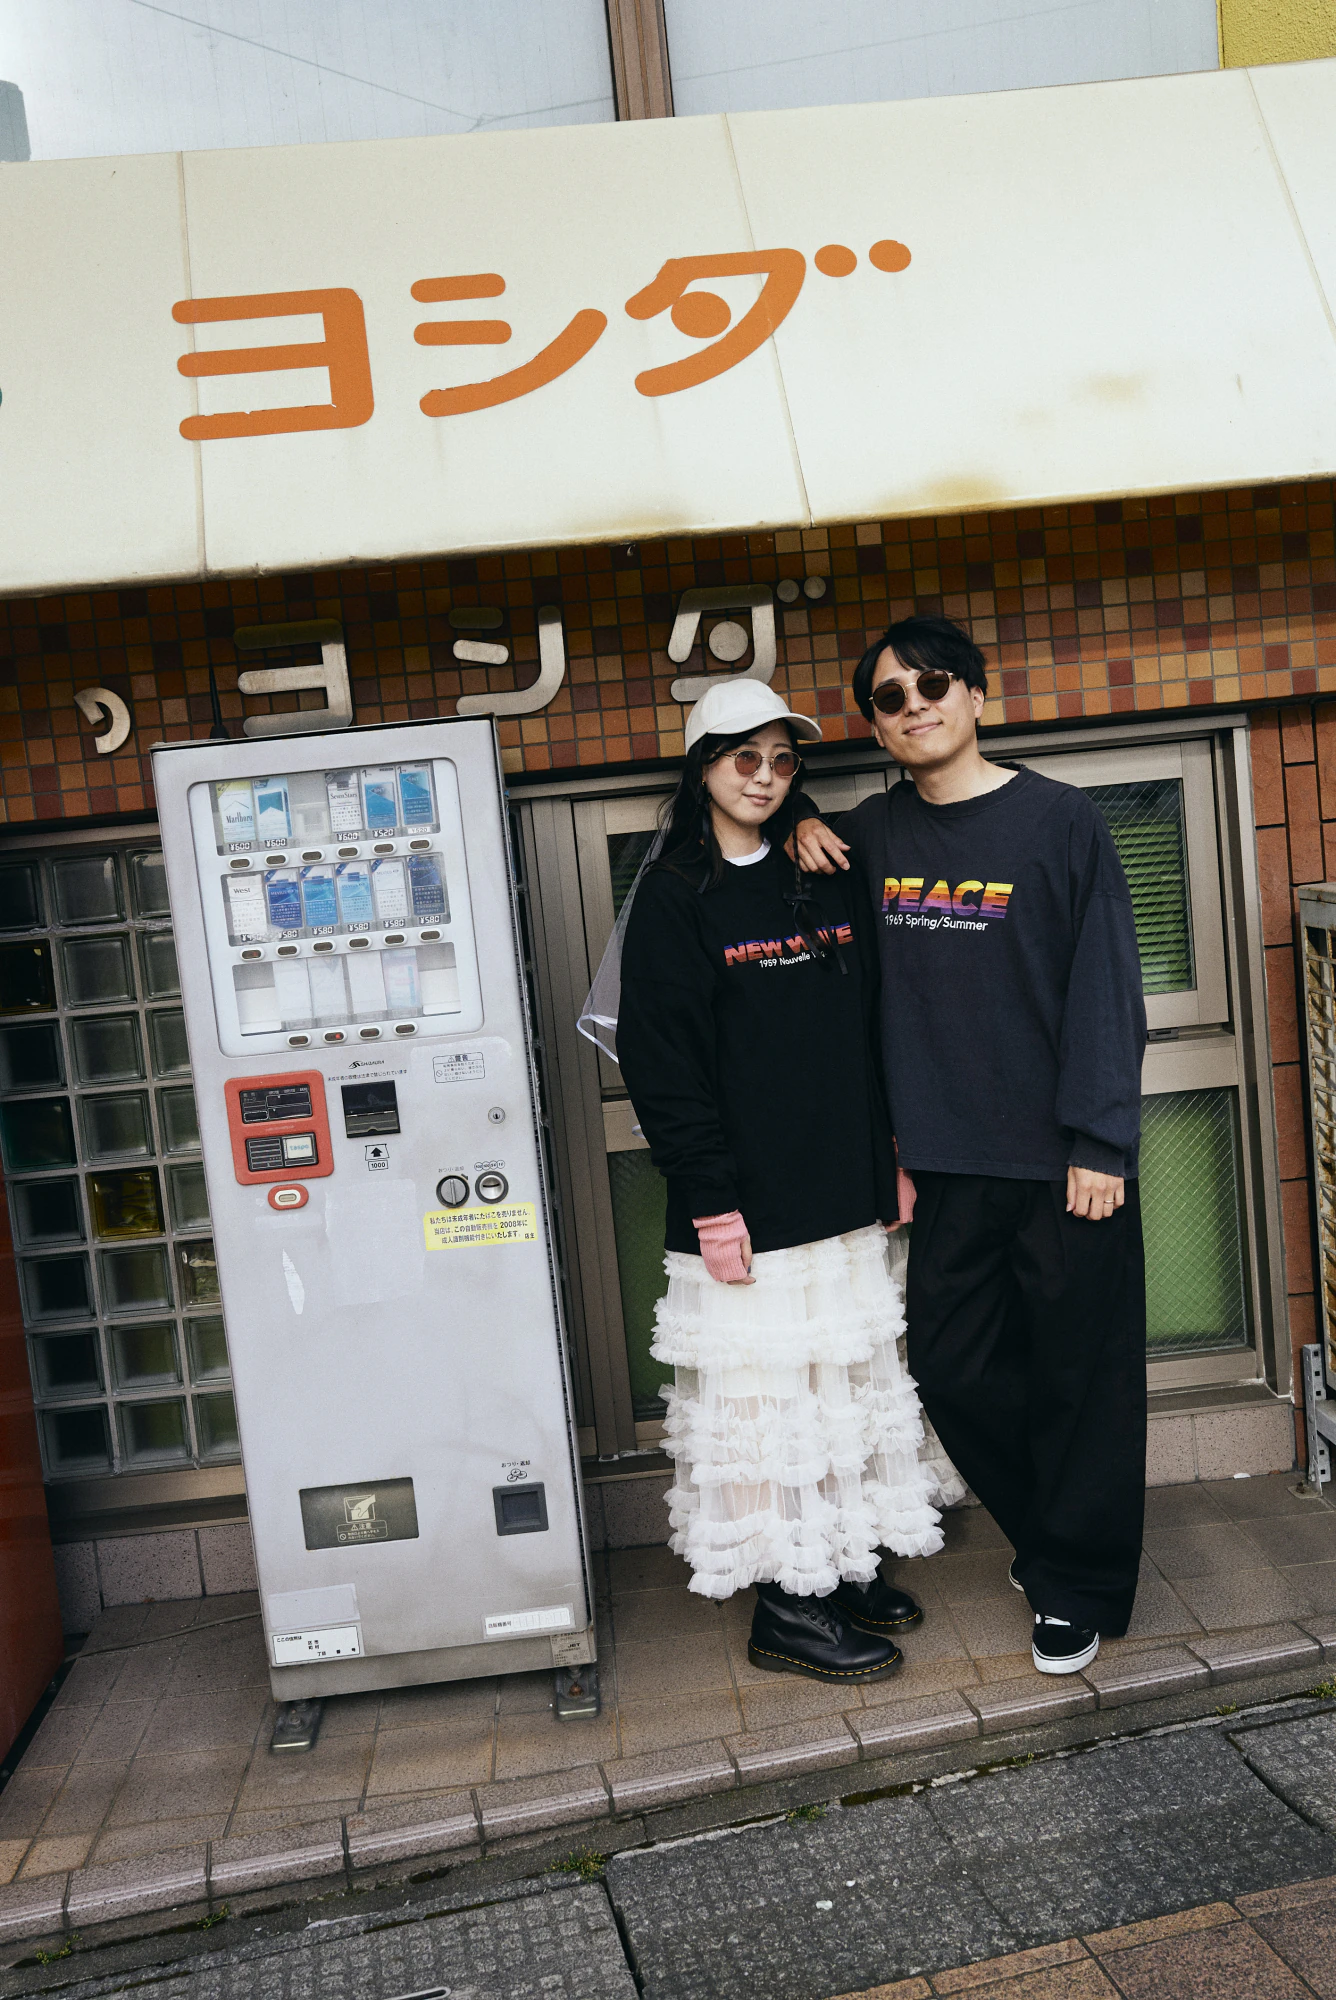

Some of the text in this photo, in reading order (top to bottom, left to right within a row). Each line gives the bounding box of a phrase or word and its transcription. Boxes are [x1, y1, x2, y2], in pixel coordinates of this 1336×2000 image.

[171, 239, 912, 441] ヨシダ
[232, 575, 827, 738] ヨシダ
[226, 812, 253, 824] Marlboro
[338, 833, 358, 841] ¥600
[373, 829, 394, 838] ¥520
[230, 842, 250, 851] ¥600
[266, 838, 286, 847] ¥600
[881, 877, 1014, 919] PEACE
[384, 919, 404, 928] ¥580
[420, 915, 440, 924] ¥580
[884, 913, 989, 932] 1969 Spring/Summer
[313, 926, 333, 935] ¥580
[349, 923, 369, 932] ¥580
[723, 938, 784, 967] NEW
[759, 958, 778, 968] 1959
[779, 951, 811, 966] Nouvelle
